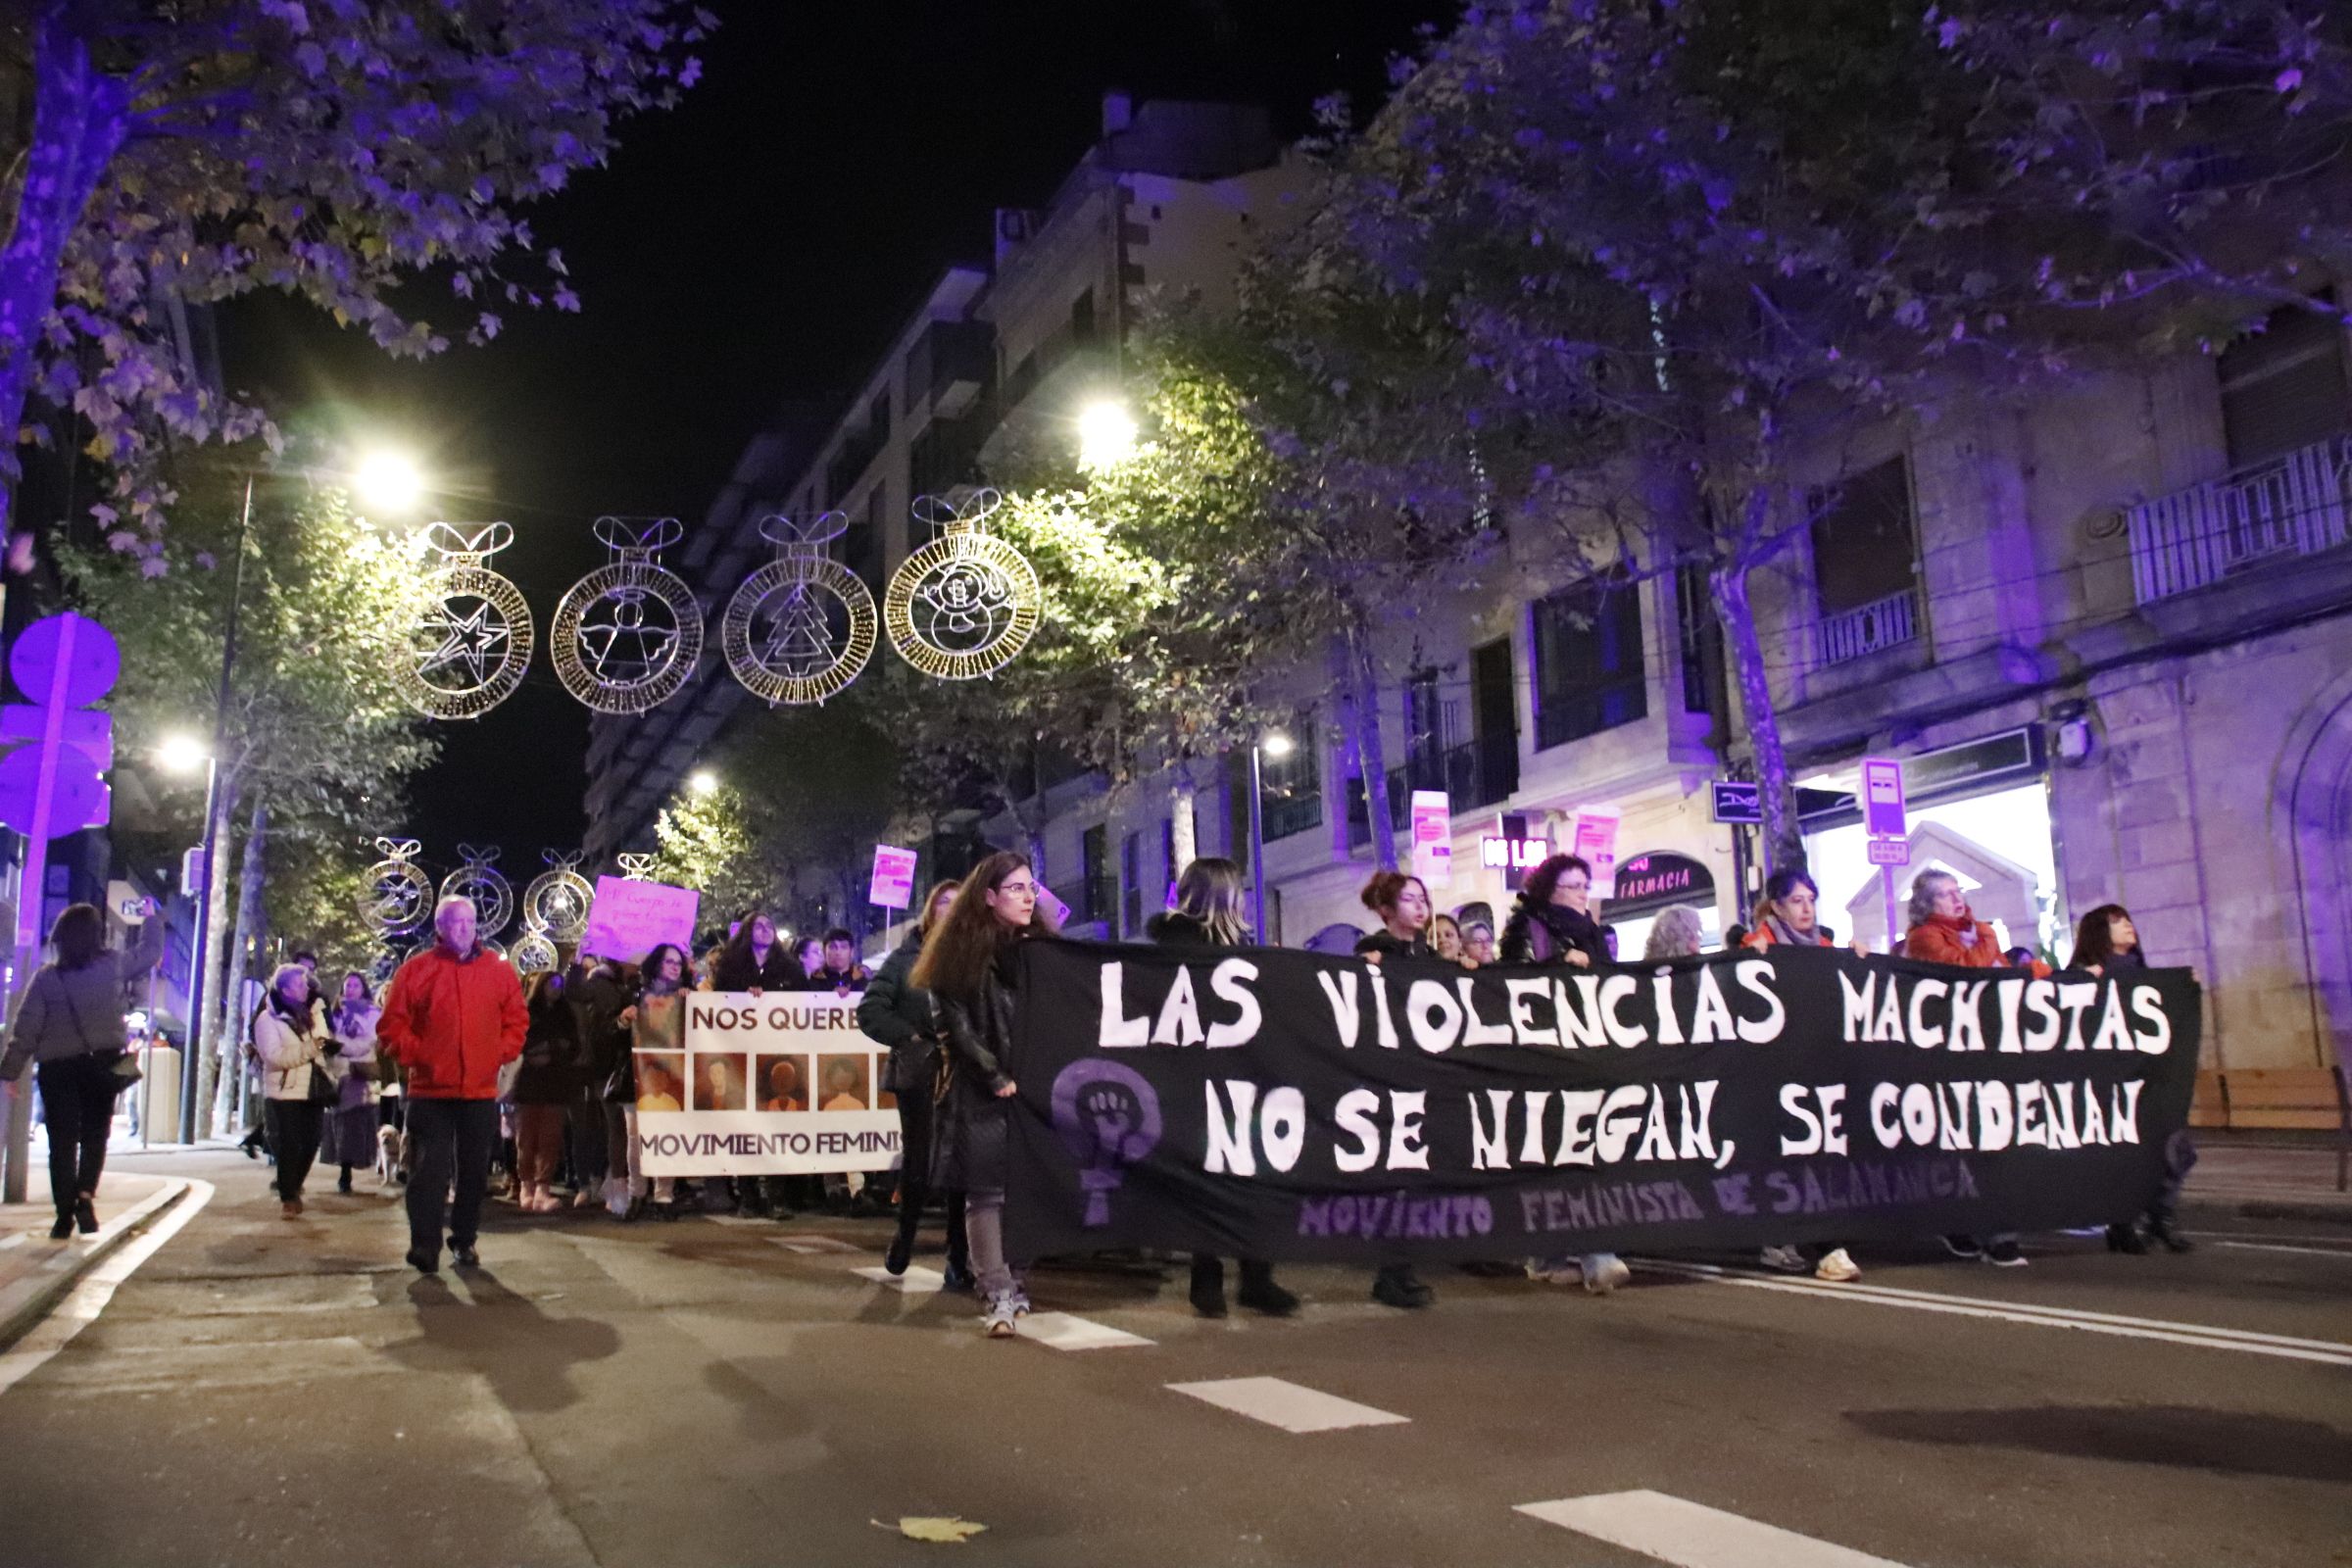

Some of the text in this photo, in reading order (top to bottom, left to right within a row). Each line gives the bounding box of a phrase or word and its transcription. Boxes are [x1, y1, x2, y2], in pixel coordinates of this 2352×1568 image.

[1620, 868, 1690, 899] FARMACIA
[692, 1006, 758, 1030] NOS
[1099, 956, 2172, 1055] LAS VIOLENCIAS MACHISTAS
[640, 1132, 810, 1156] MOVIMIENTO
[1204, 1078, 2145, 1177] NO SE NIEGAN, SE CONDENAN
[1519, 1179, 1704, 1233] FEMINISTA
